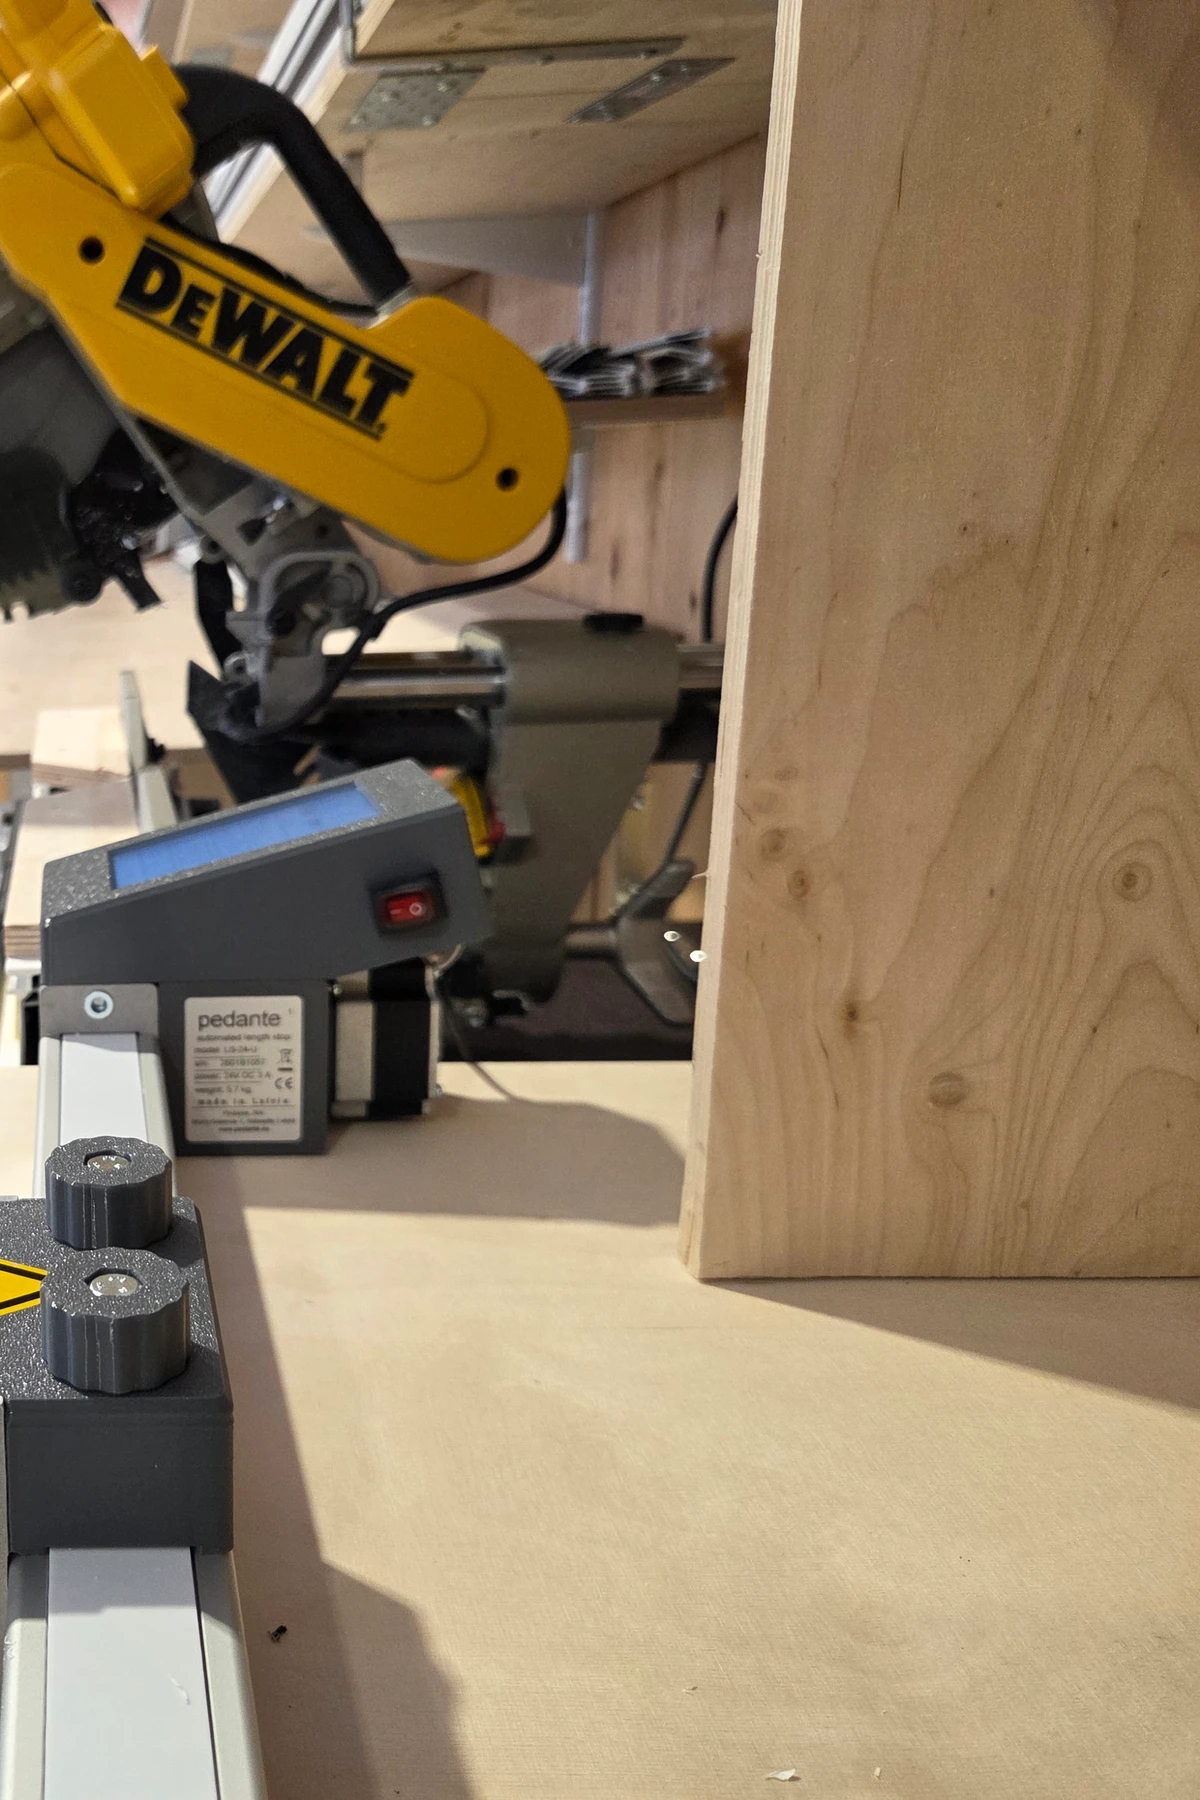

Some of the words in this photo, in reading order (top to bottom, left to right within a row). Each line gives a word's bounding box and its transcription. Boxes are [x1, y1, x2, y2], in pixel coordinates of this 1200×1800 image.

[198, 1010, 281, 1031] pedante
[197, 1034, 241, 1042] automated
[243, 1033, 270, 1043] length
[273, 1033, 291, 1041] stop
[196, 1096, 228, 1105] made
